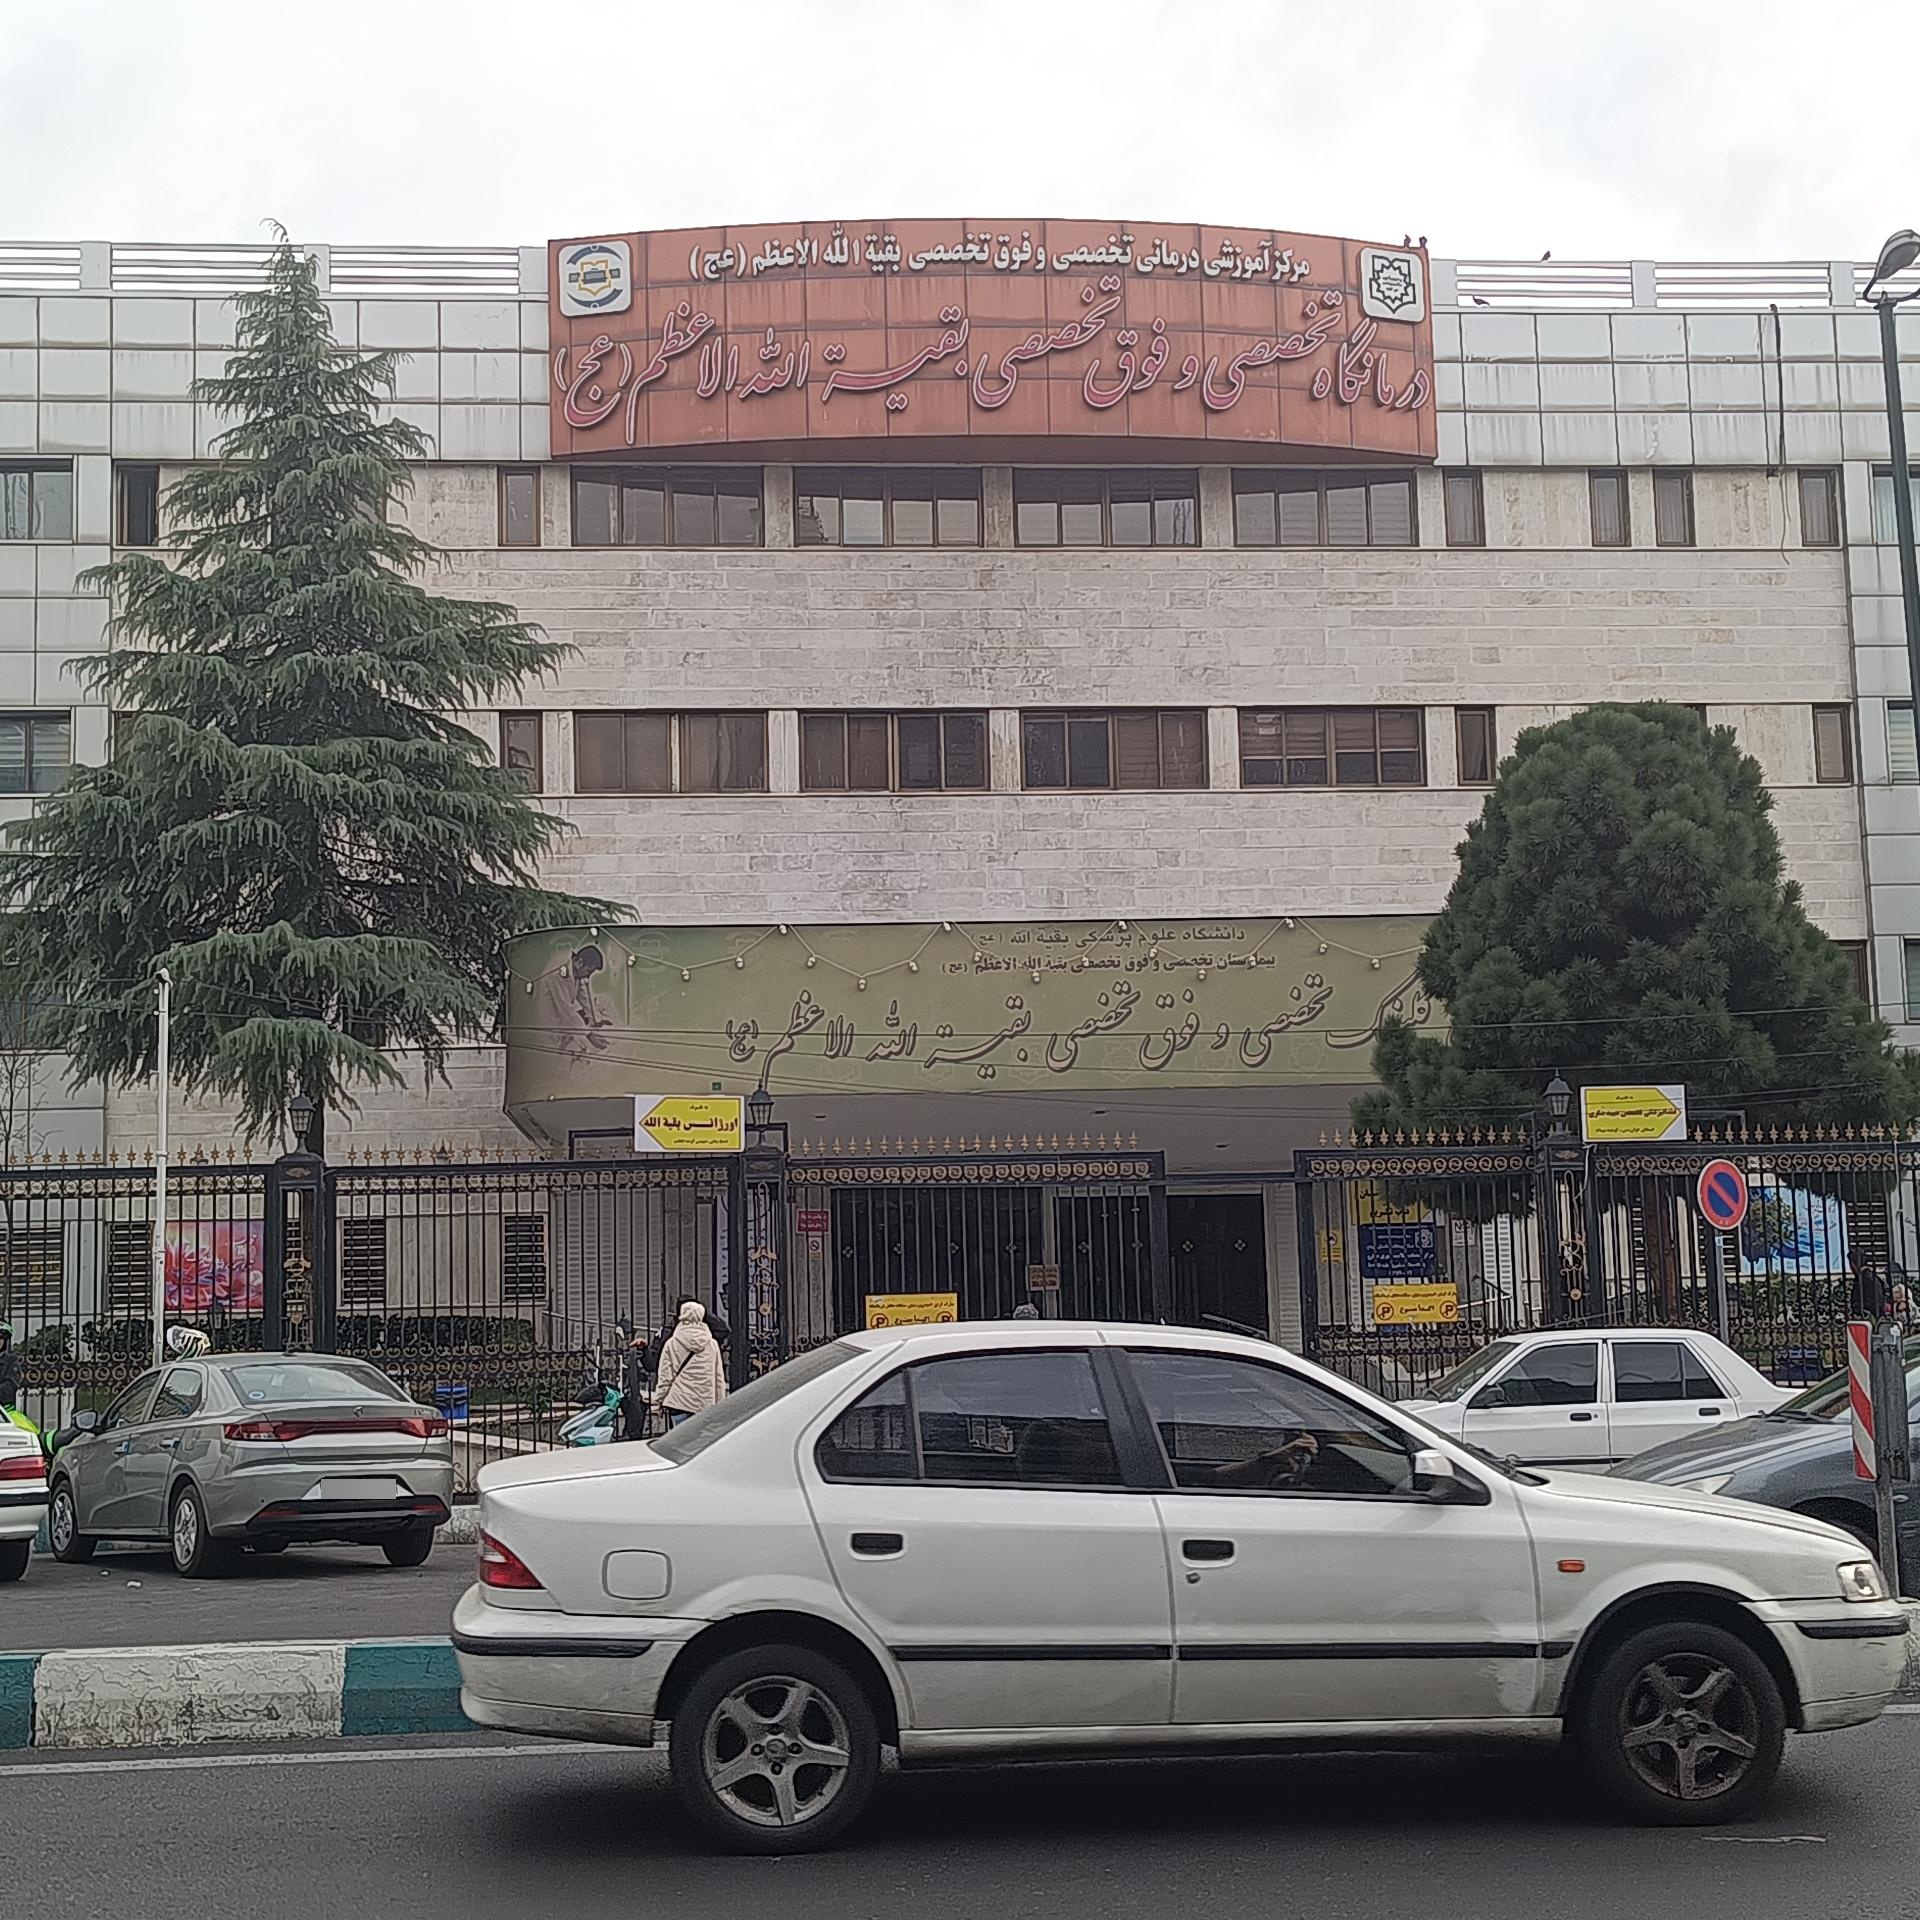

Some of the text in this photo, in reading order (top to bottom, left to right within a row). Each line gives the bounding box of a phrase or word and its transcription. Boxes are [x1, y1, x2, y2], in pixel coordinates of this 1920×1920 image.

[752, 239, 818, 277] الاعظم
[908, 233, 993, 271] تخصصی
[994, 230, 1034, 270] فوق
[1034, 247, 1047, 270] و
[1052, 233, 1136, 271] تخصصی
[1136, 236, 1200, 274] درمانی
[1203, 240, 1272, 279] آموزشی
[1272, 247, 1311, 285] مرکز
[973, 275, 1121, 408] تخصصی
[1202, 289, 1343, 410] تخصصی
[625, 301, 740, 446] الاعظم
[1084, 316, 1171, 409] فوق
[1174, 354, 1200, 391] و
[1312, 316, 1431, 410] درمانگاه
[1075, 928, 1134, 949] پزشکی
[1137, 927, 1177, 947] علوم
[1182, 927, 1246, 942] دانشگاه
[1124, 956, 1151, 973] فوق
[1046, 980, 1140, 1073] تخصصی
[1139, 989, 1200, 1070] فوق
[1212, 1023, 1230, 1050] و
[1239, 974, 1333, 1067] تخصصی
